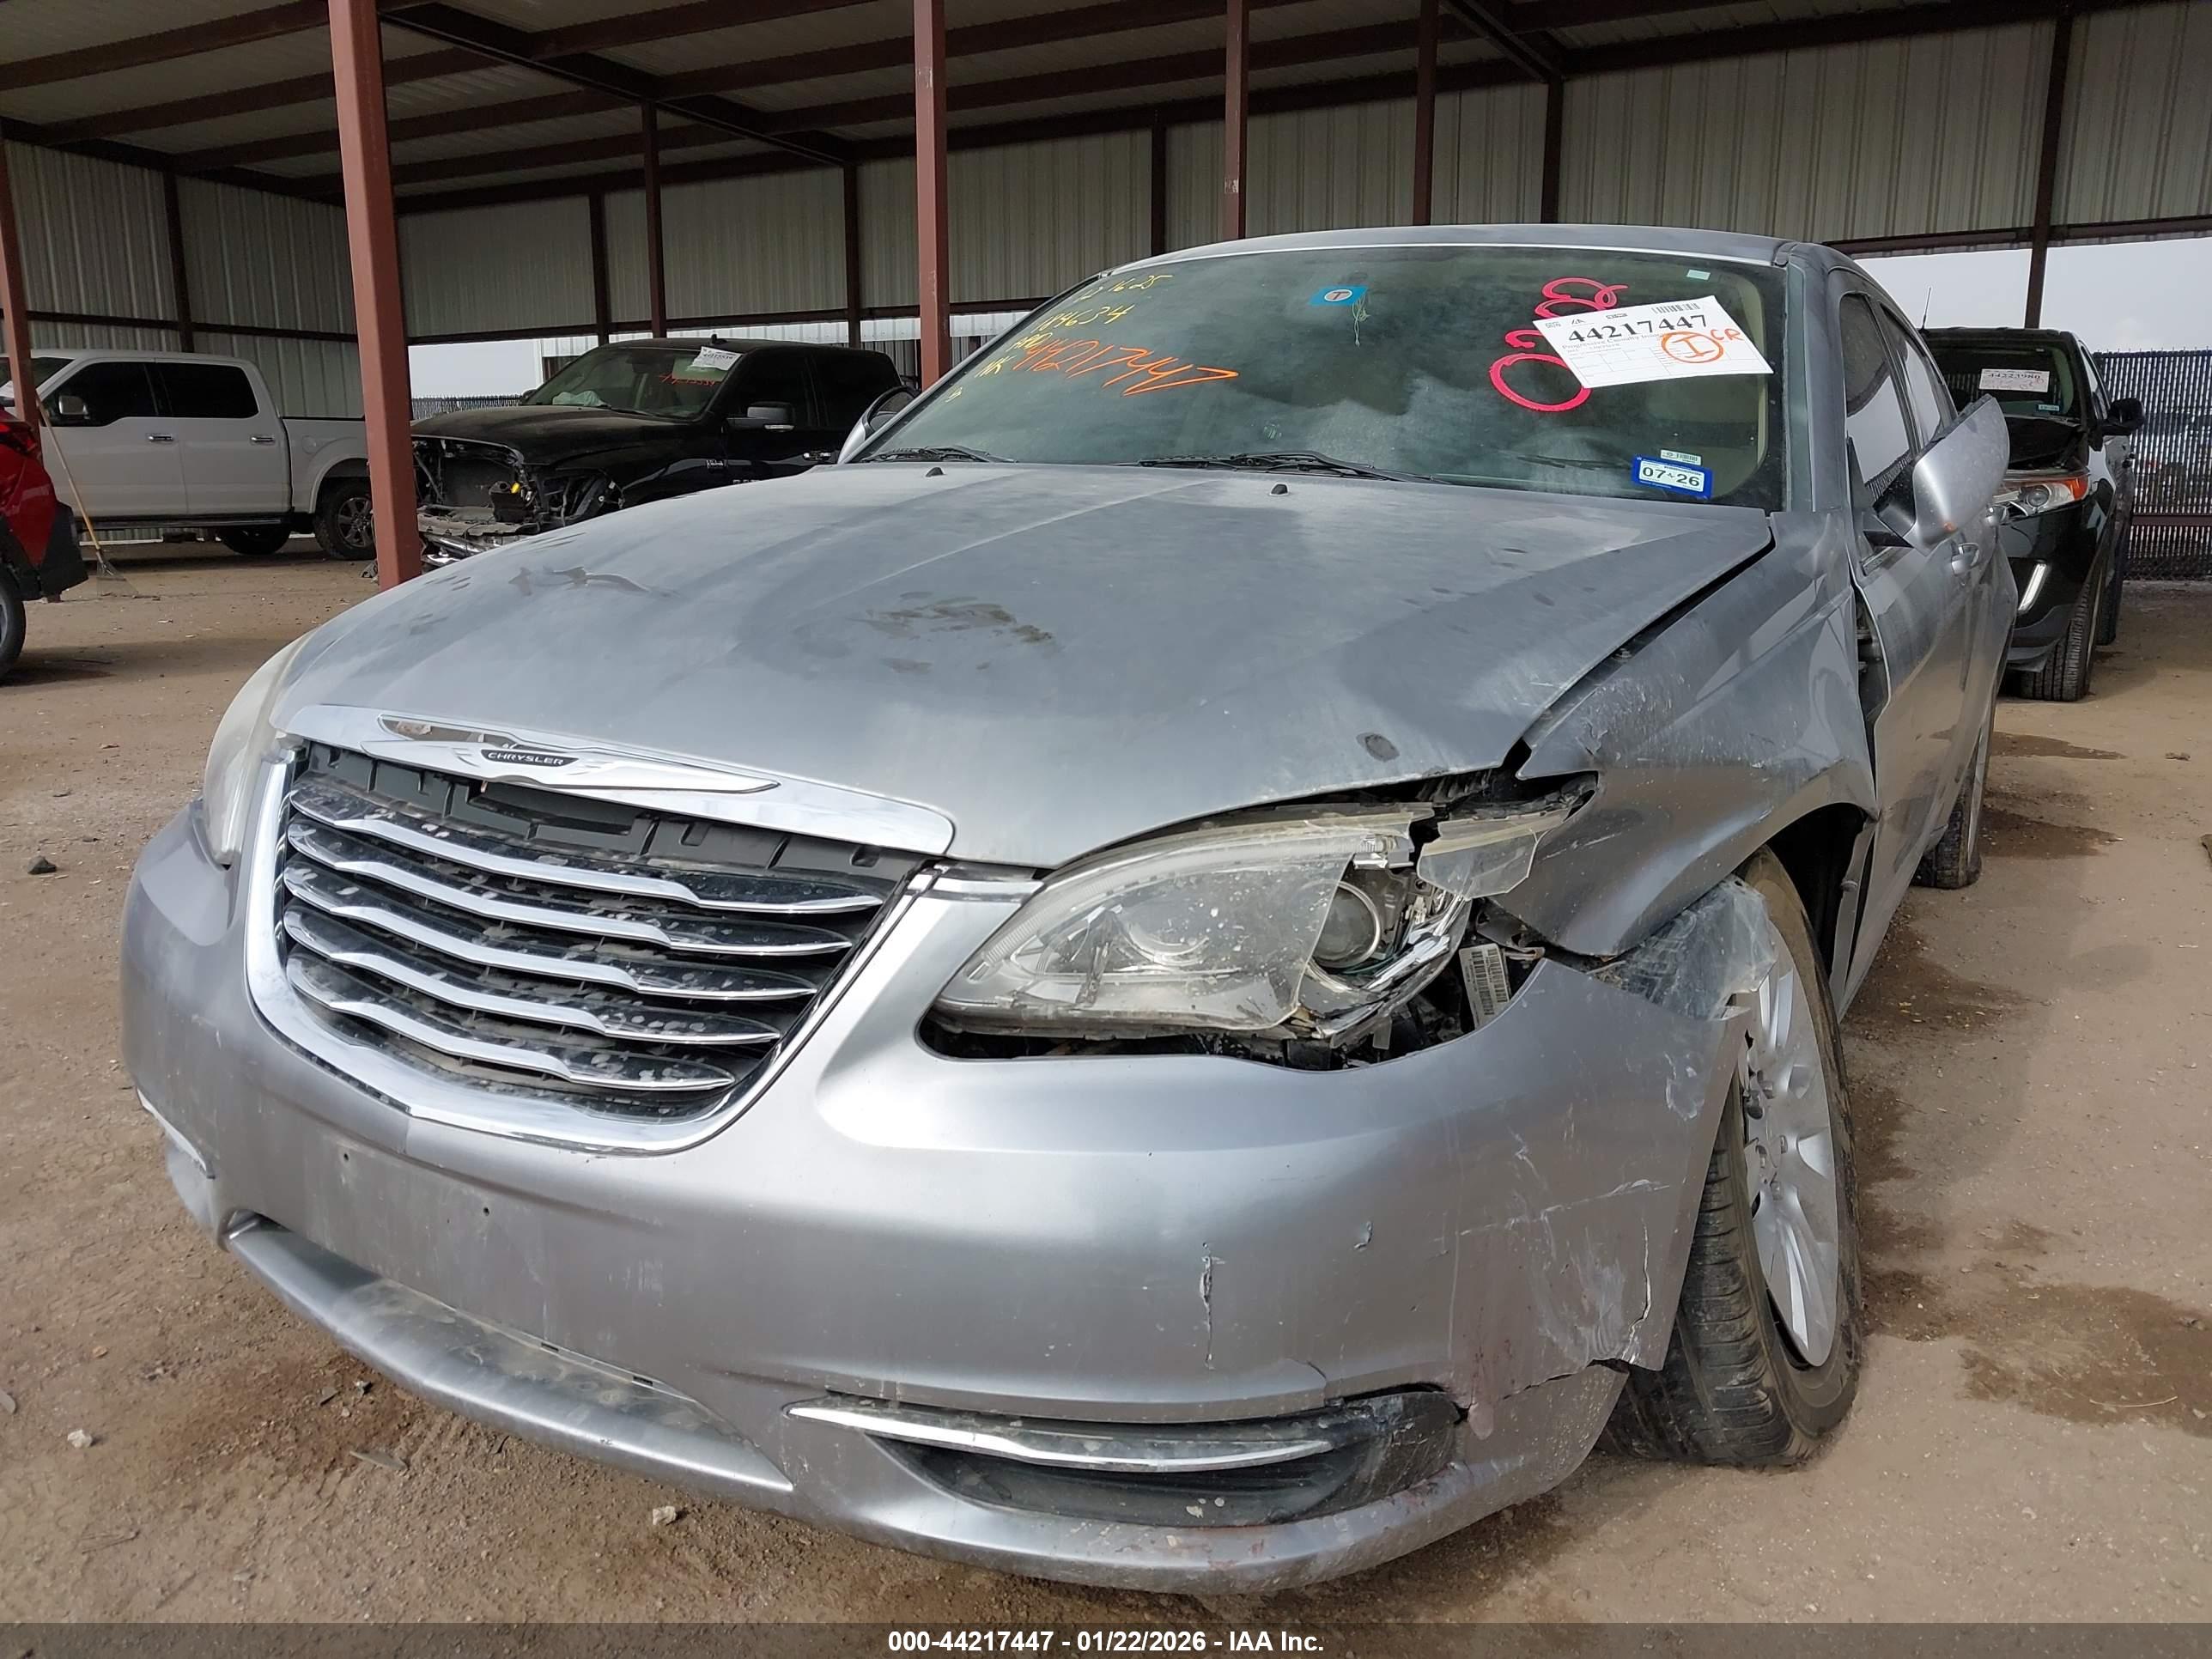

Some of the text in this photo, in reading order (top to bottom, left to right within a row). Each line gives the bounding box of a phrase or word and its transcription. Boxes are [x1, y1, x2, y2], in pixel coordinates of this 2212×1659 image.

[1569, 314, 1706, 342] 44217447
[1012, 337, 1238, 397] 44217447
[1642, 467, 1667, 479] 07
[1676, 473, 1700, 487] 26
[488, 752, 564, 765] CHRYSLER
